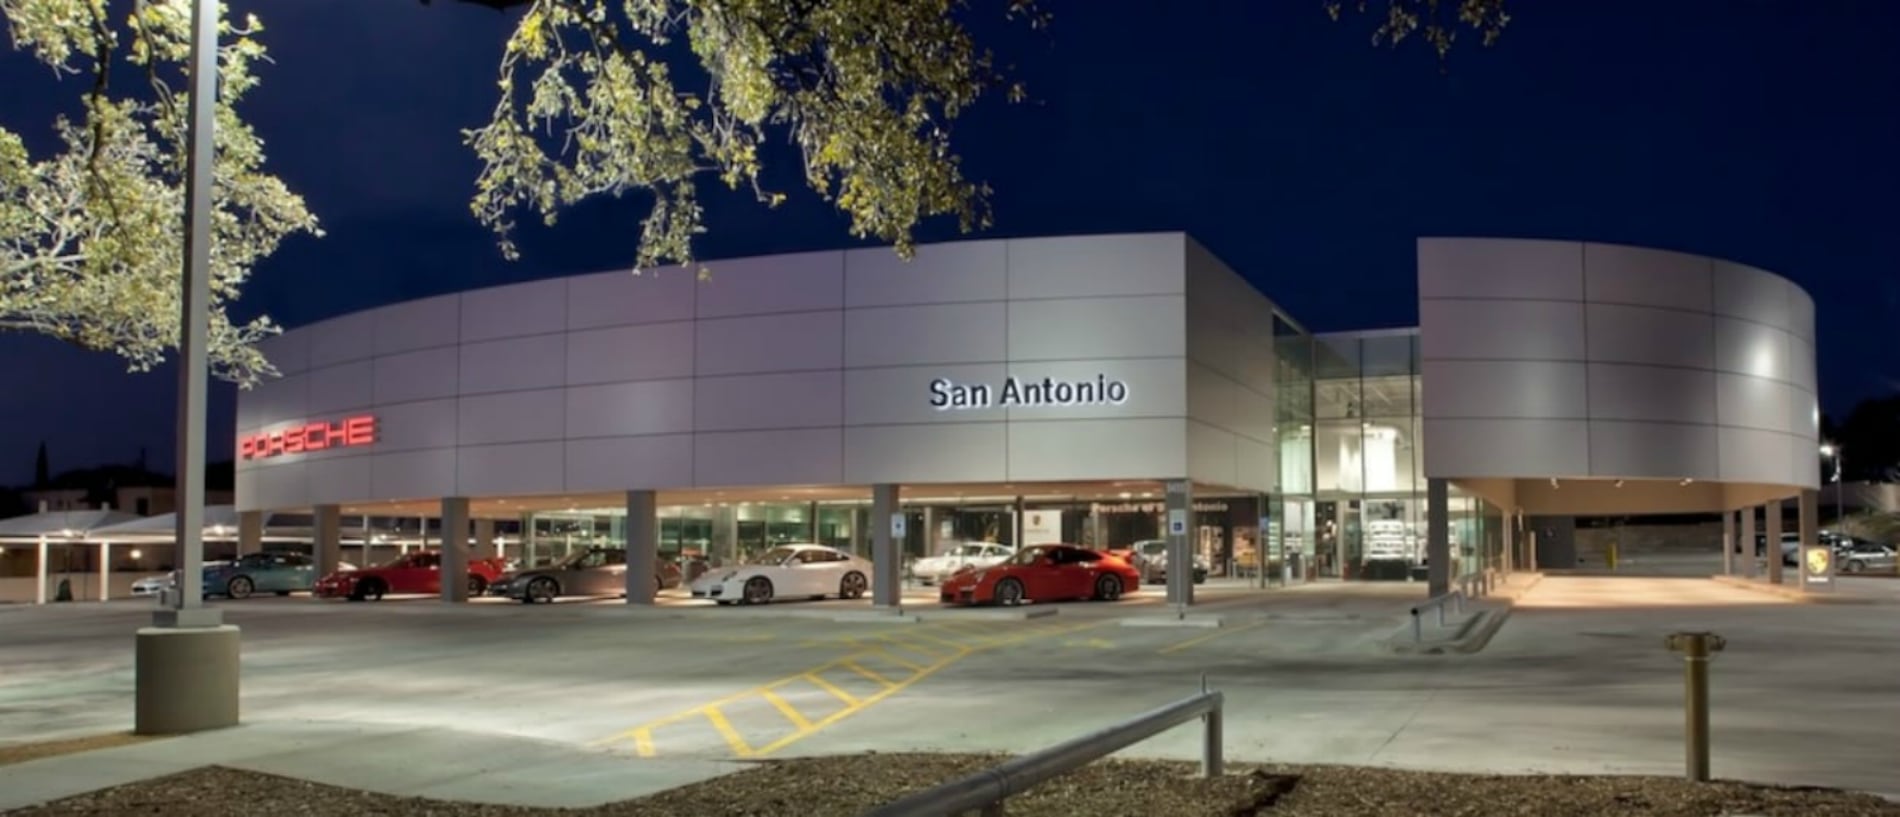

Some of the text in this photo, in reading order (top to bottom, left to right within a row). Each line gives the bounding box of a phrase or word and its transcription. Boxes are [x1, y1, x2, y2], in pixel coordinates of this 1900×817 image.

[929, 373, 1128, 409] San Antonio
[239, 415, 375, 458] PORSCHE
